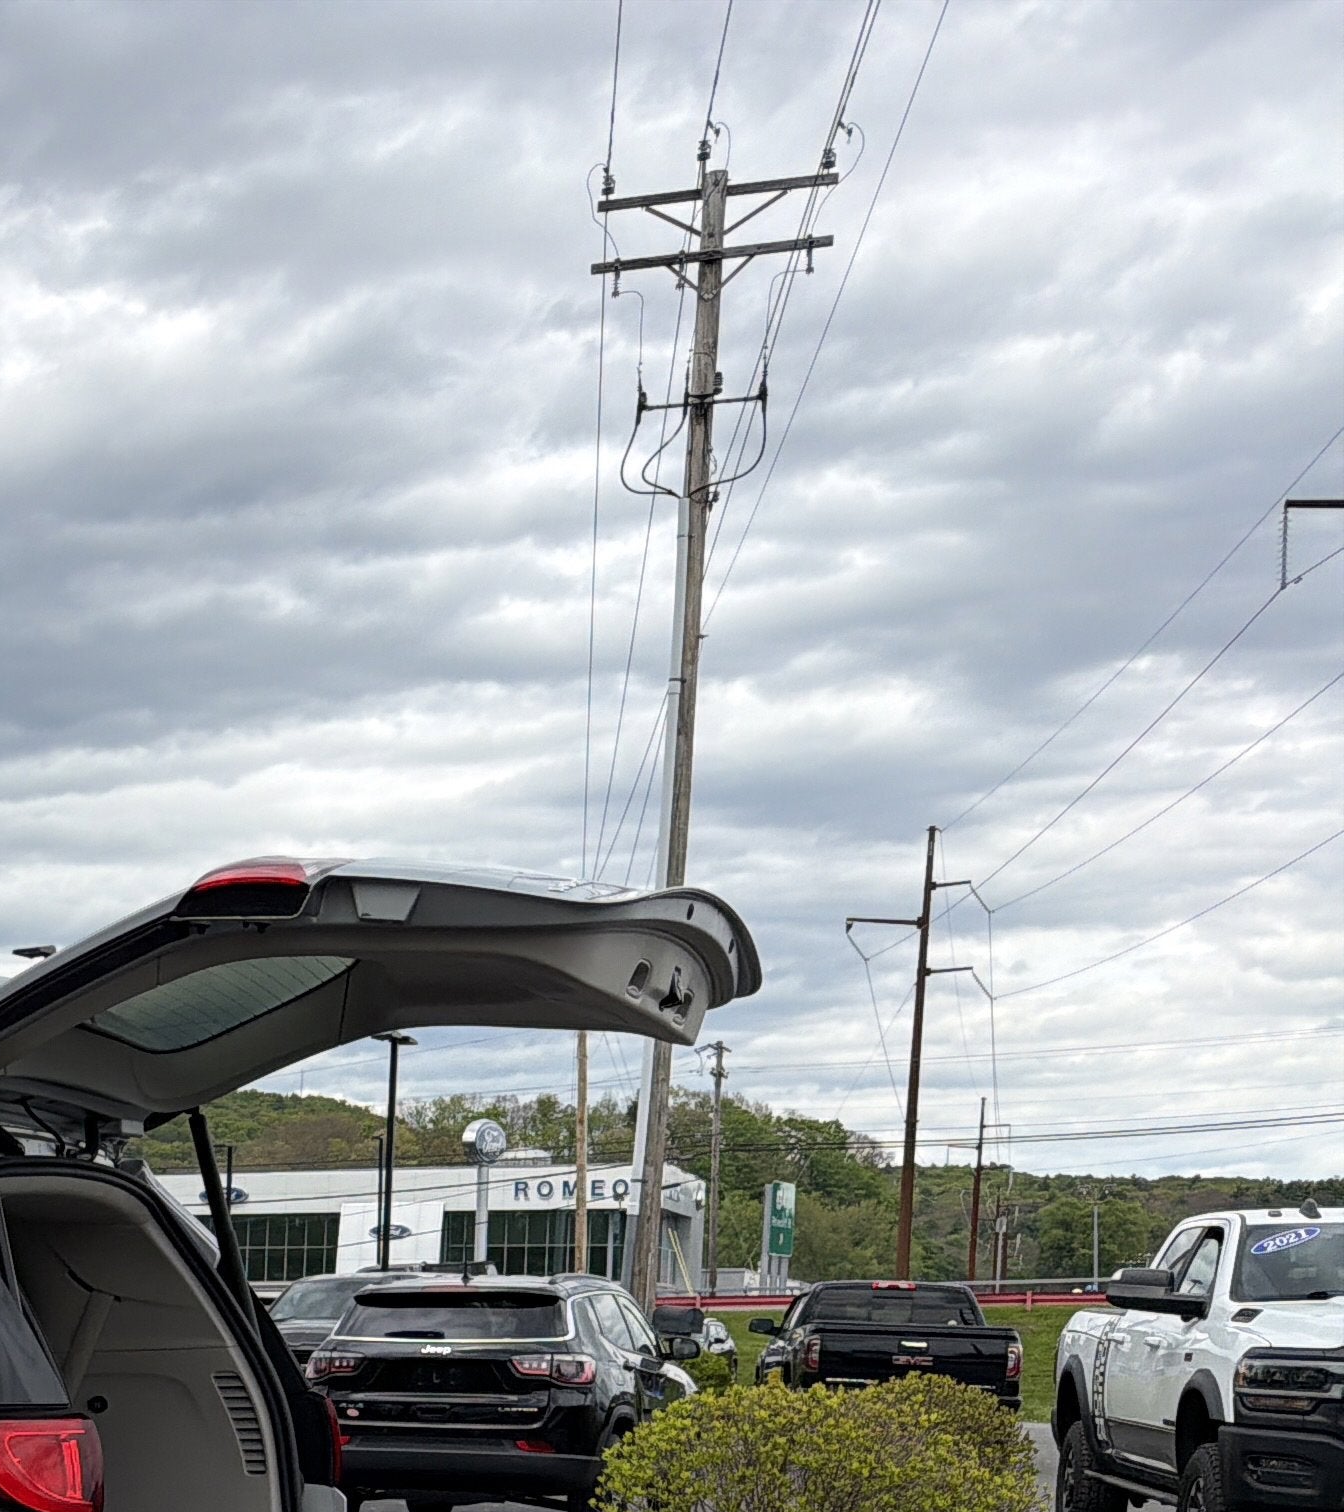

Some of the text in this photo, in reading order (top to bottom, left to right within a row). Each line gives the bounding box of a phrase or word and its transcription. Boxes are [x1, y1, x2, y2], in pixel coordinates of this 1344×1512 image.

[514, 1179, 628, 1199] ROMEO
[1264, 1229, 1309, 1252] 2021
[420, 1344, 452, 1356] Jeep
[892, 1355, 933, 1366] GMC
